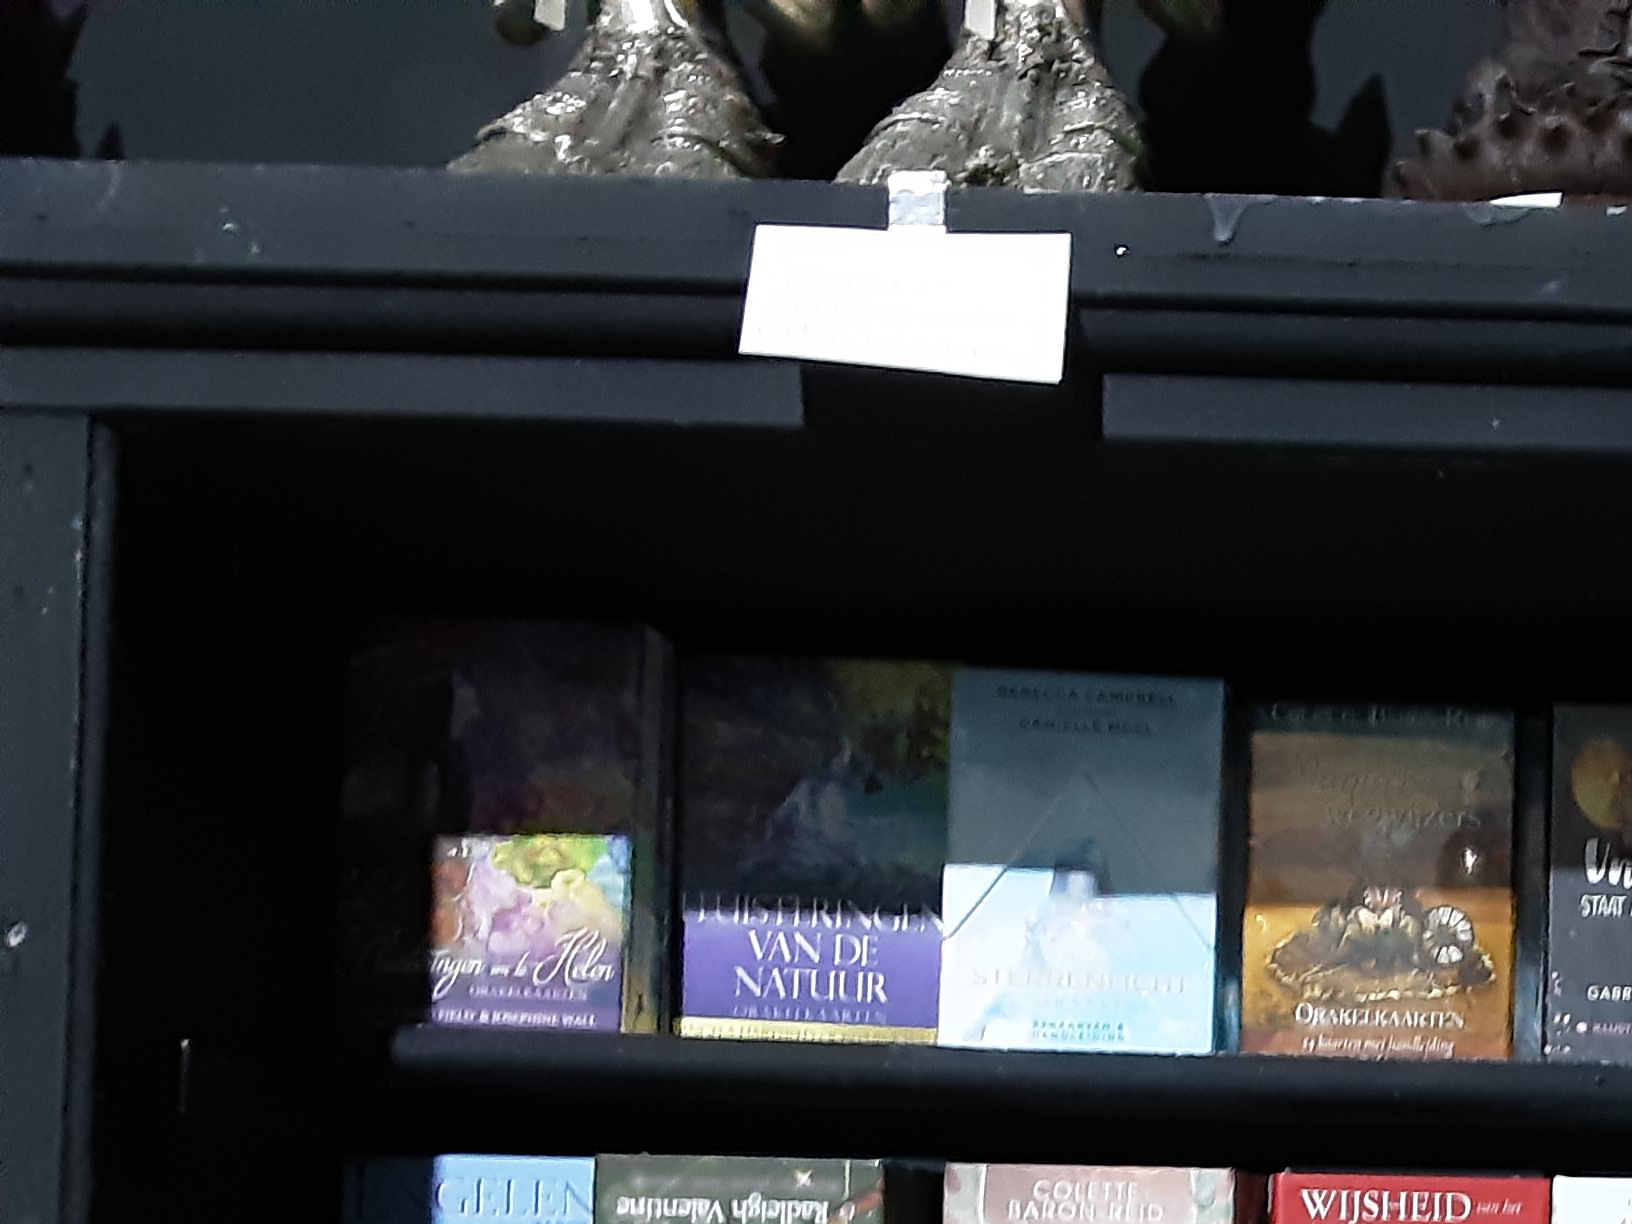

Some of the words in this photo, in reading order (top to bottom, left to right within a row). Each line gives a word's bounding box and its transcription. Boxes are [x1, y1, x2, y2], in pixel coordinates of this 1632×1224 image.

[1580, 894, 1627, 919] STAAT
[747, 929, 822, 964] VAN
[833, 934, 880, 967] DE
[733, 965, 889, 1004] NATUUR
[1299, 1188, 1473, 1222] WIJSHEID
